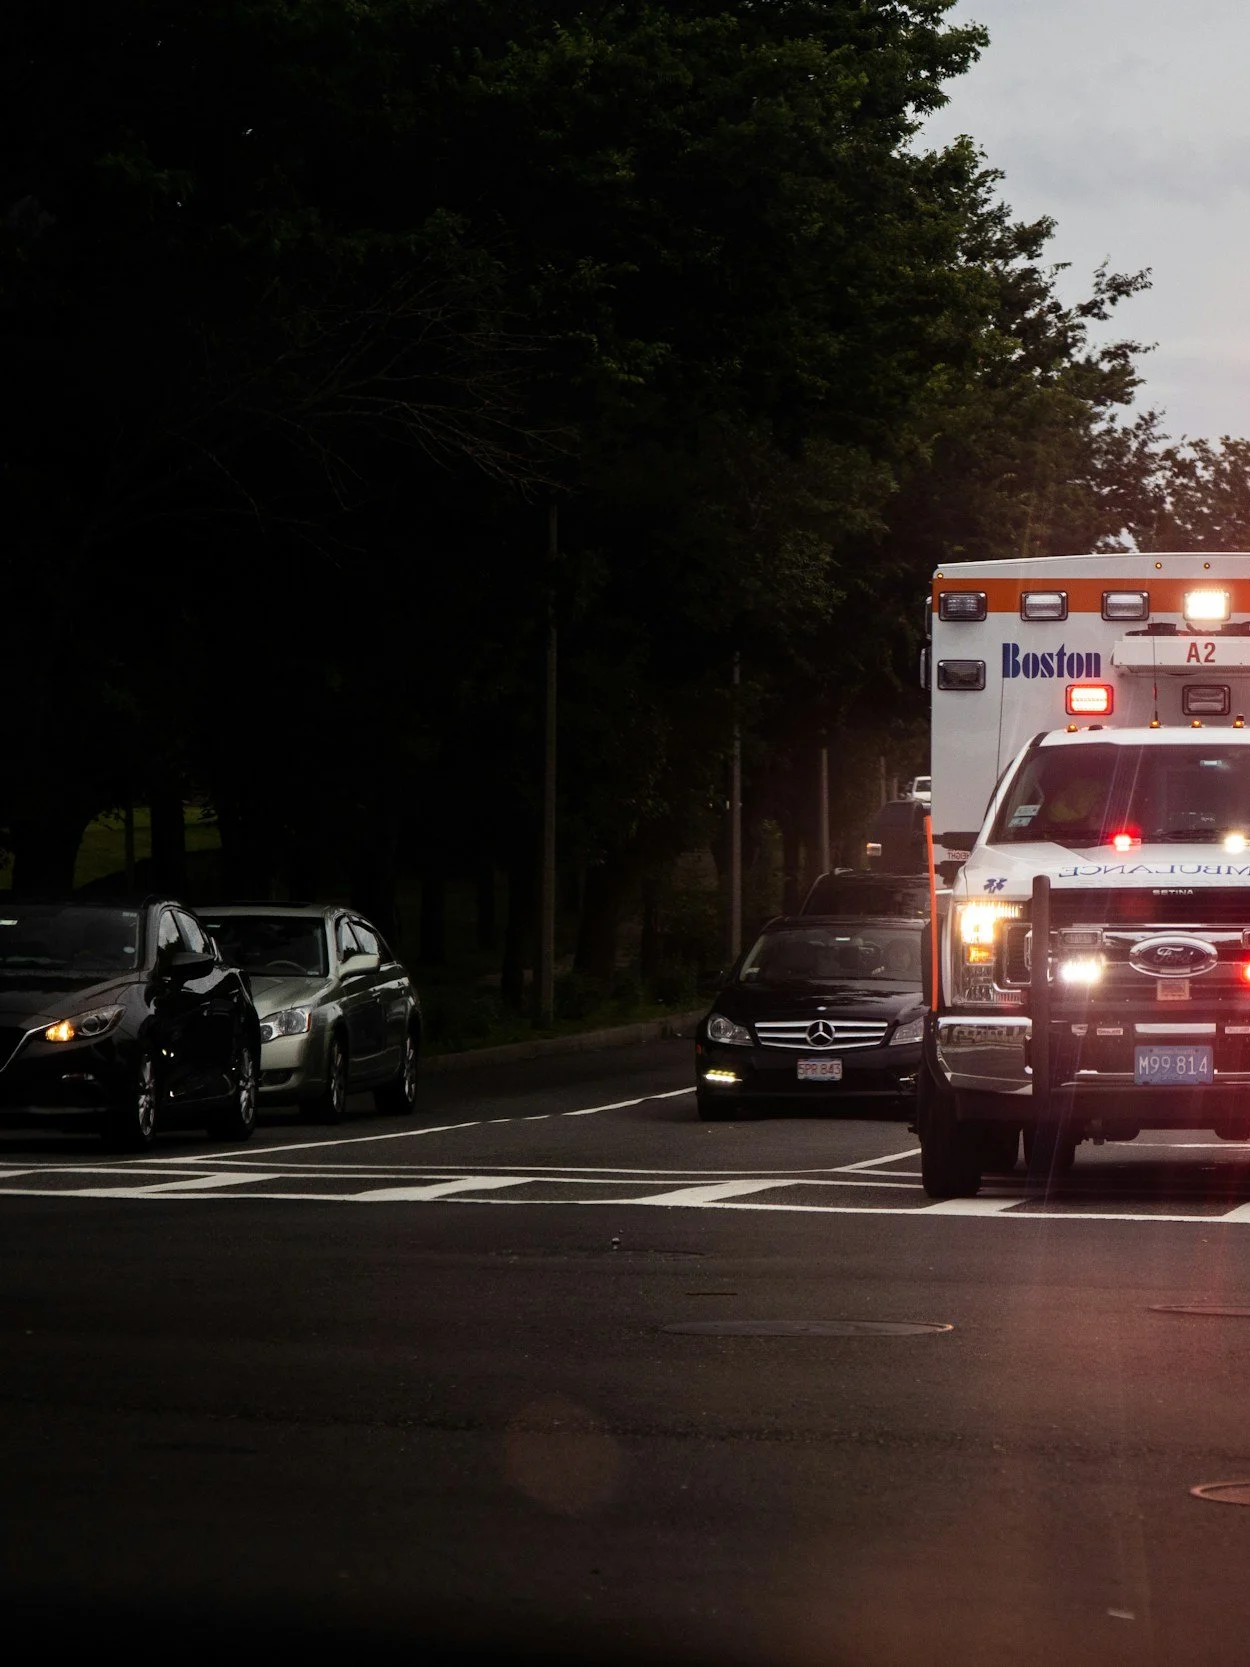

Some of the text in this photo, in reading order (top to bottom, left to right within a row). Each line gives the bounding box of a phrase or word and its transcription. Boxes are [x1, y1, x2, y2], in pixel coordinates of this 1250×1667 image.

[1002, 643, 1100, 678] Boston
[1186, 642, 1216, 664] A2
[1153, 946, 1194, 965] Ford
